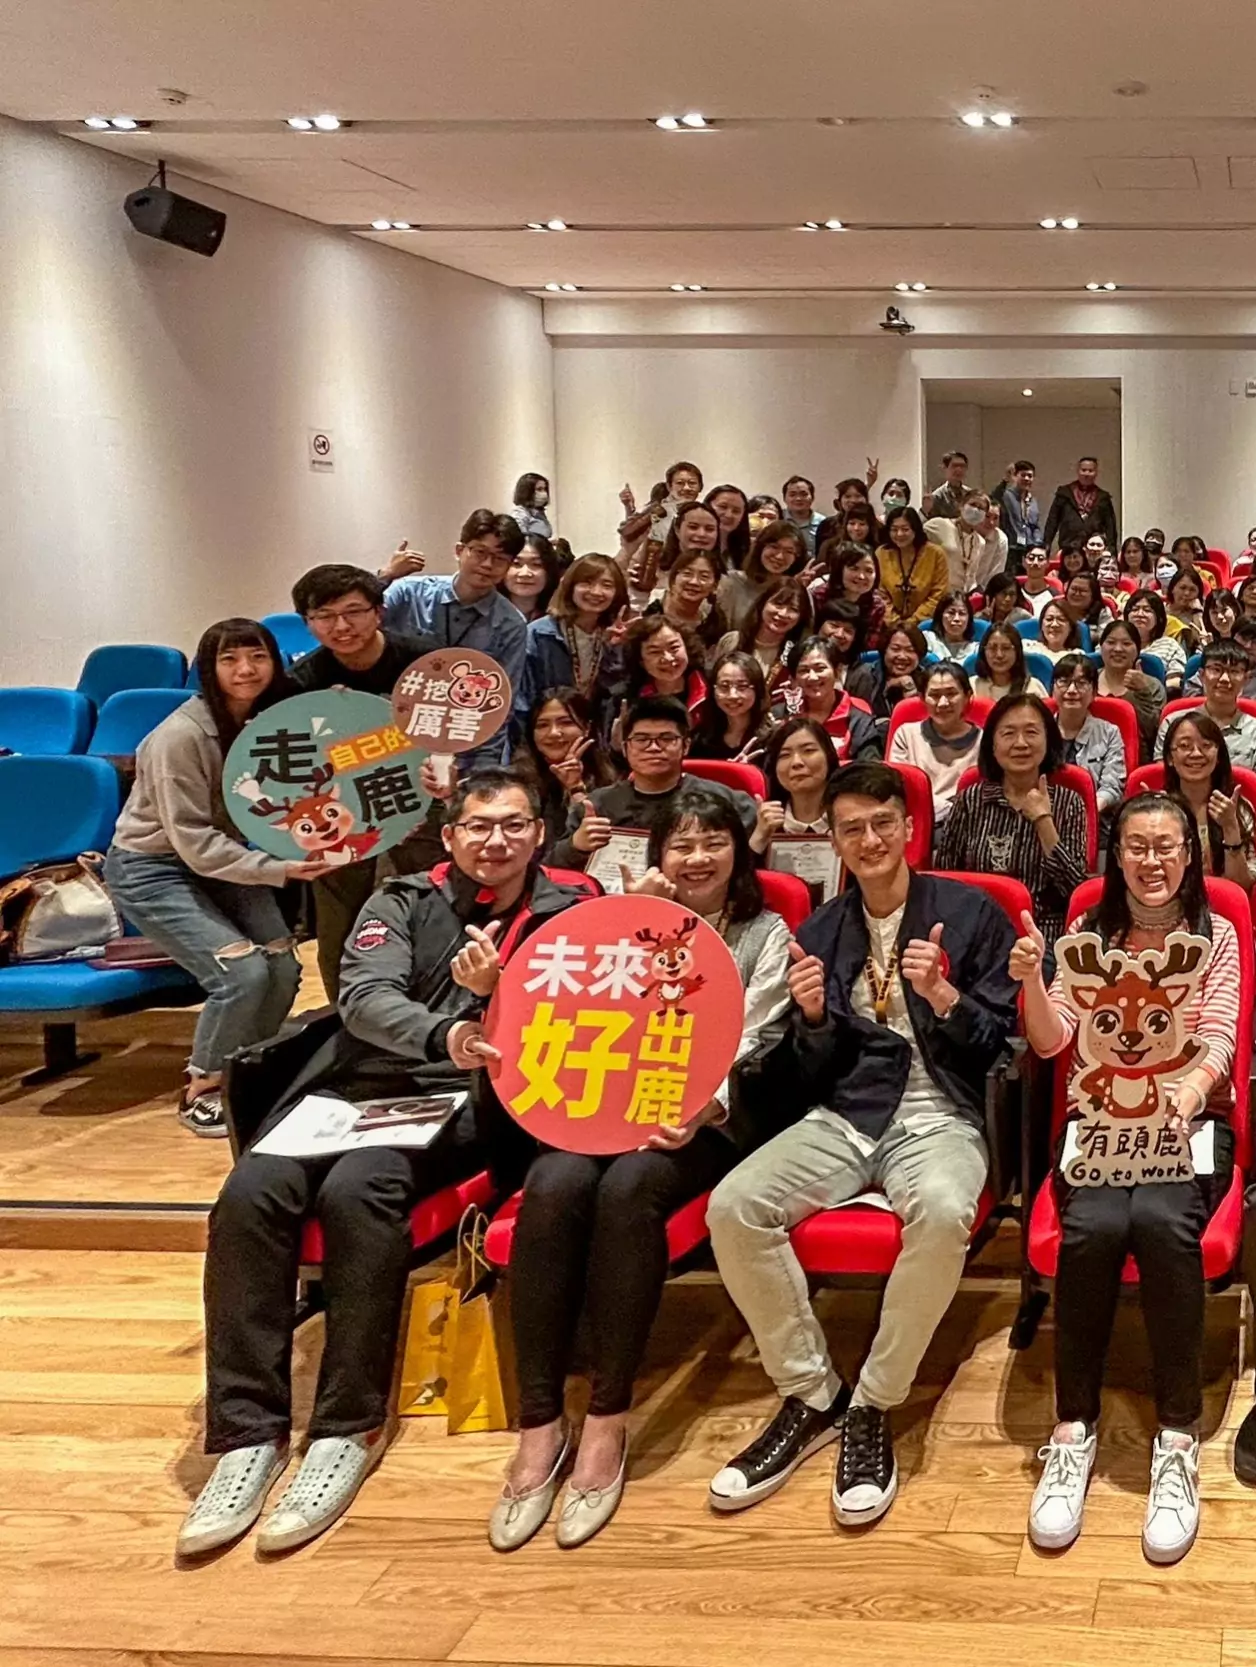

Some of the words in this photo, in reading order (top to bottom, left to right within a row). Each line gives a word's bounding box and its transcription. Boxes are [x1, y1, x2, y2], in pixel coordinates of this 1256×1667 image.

[330, 725, 412, 770] 自己的
[405, 703, 483, 741] 厲害
[250, 728, 317, 785] 走
[353, 764, 421, 823] 鹿
[523, 935, 653, 999] 未來
[509, 1002, 635, 1119] 好
[624, 1007, 694, 1127] 出鹿
[1080, 1120, 1182, 1159] 有頭鹿
[1112, 1168, 1132, 1181] to
